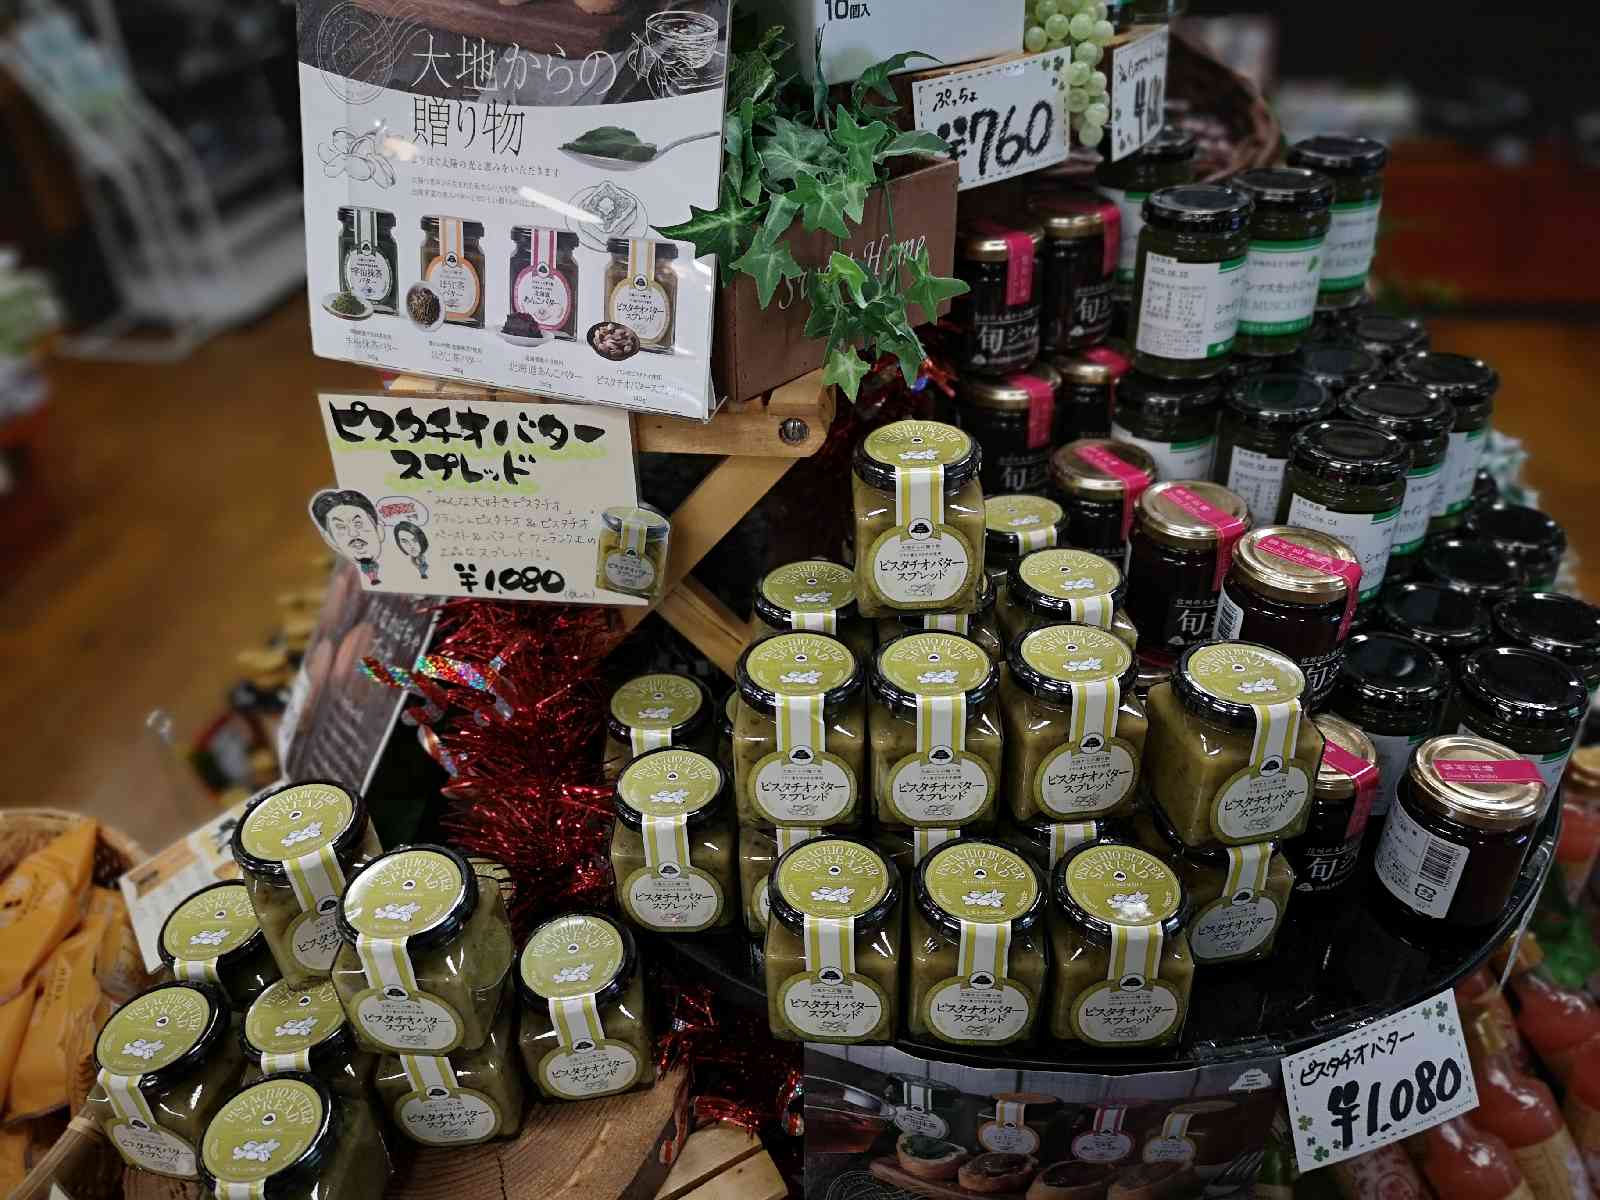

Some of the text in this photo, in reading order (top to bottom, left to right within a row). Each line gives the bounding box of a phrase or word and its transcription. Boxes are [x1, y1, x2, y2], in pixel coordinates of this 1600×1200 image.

[409, 33, 618, 95] 大地からの
[411, 97, 527, 157] 贈り物
[936, 100, 1053, 176] ¥760
[328, 400, 606, 450] ピスタチオバター
[389, 449, 538, 486] スプレッド
[879, 557, 965, 572] ピスタチオバター
[896, 569, 948, 582] スプレッド
[1047, 768, 1131, 787] ピスタチオバター
[760, 781, 848, 795] ピスタチオバター
[898, 780, 985, 794] ピスタチオバター
[1063, 776, 1115, 795] スプレッド
[778, 791, 830, 802] スプレッド
[915, 790, 968, 802] スプレッド
[634, 892, 714, 903] ピスタチオバター
[790, 998, 879, 1012] ピスタチオバター
[937, 1002, 1025, 1015] ピスタチオバター
[1085, 1005, 1176, 1018] ピスタチオバター
[808, 1009, 865, 1021] スプレッド
[953, 1013, 1009, 1024] スプレッド
[1103, 1014, 1156, 1026] スプレッド
[1300, 1030, 1415, 1087] ピスタチオバター
